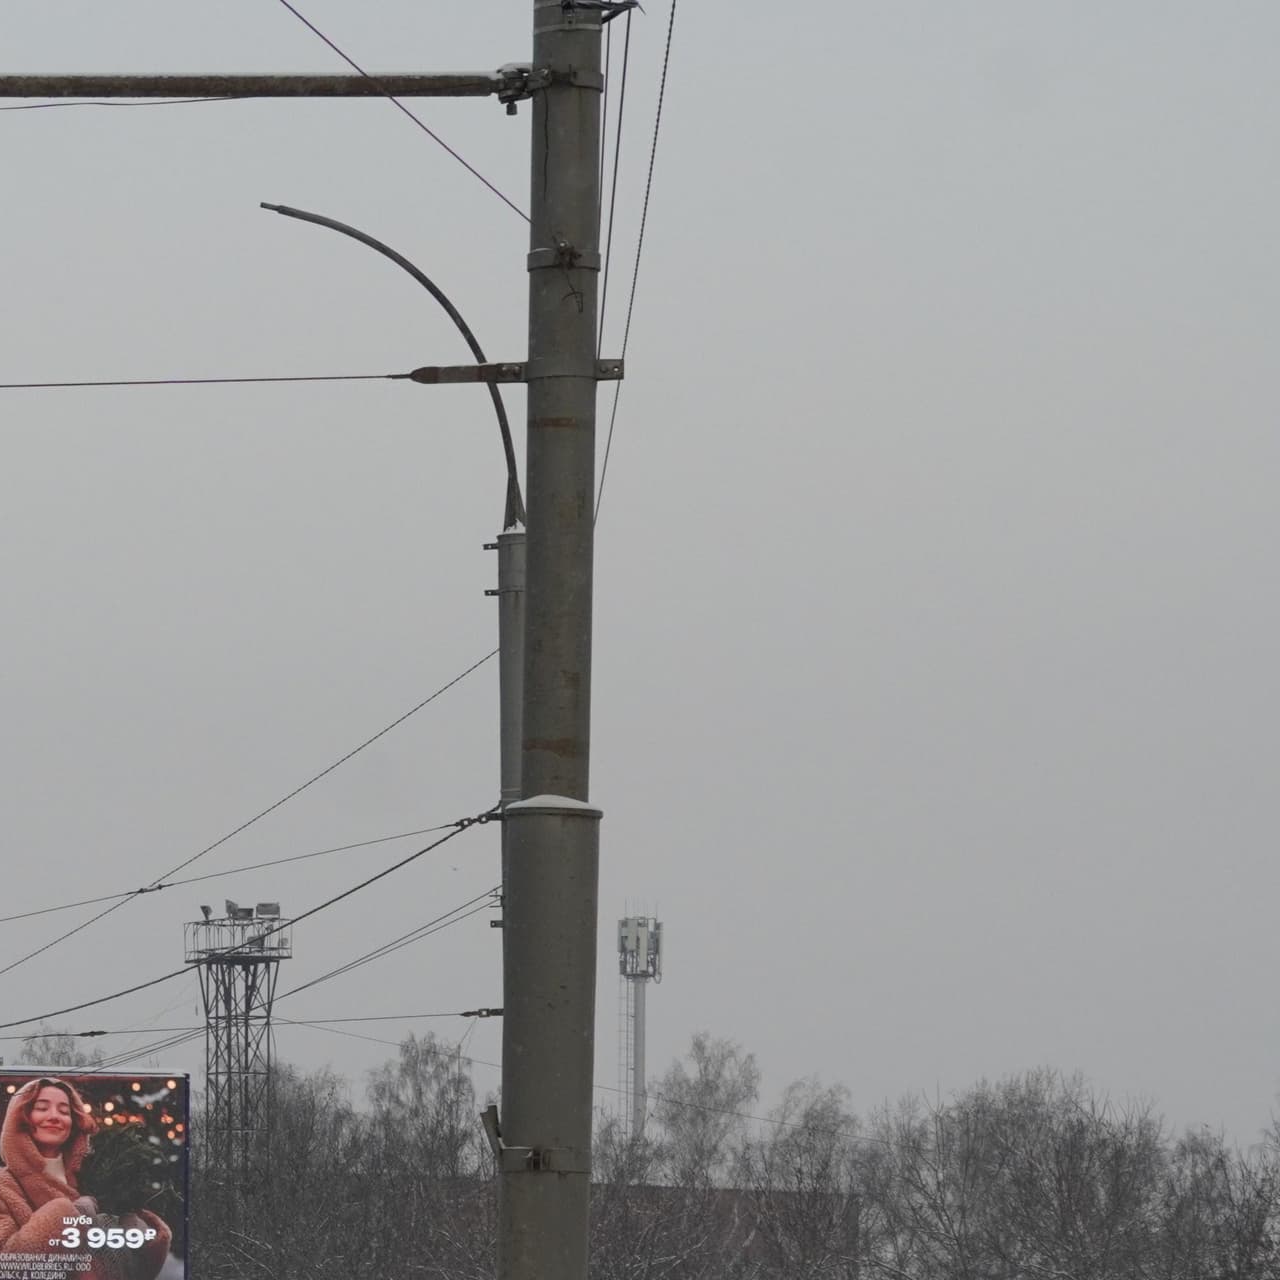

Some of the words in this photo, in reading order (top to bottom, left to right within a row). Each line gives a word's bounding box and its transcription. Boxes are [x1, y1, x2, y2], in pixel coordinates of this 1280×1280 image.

[63, 1215, 93, 1227] шуба
[48, 1238, 61, 1247] от
[61, 1227, 81, 1249] 3
